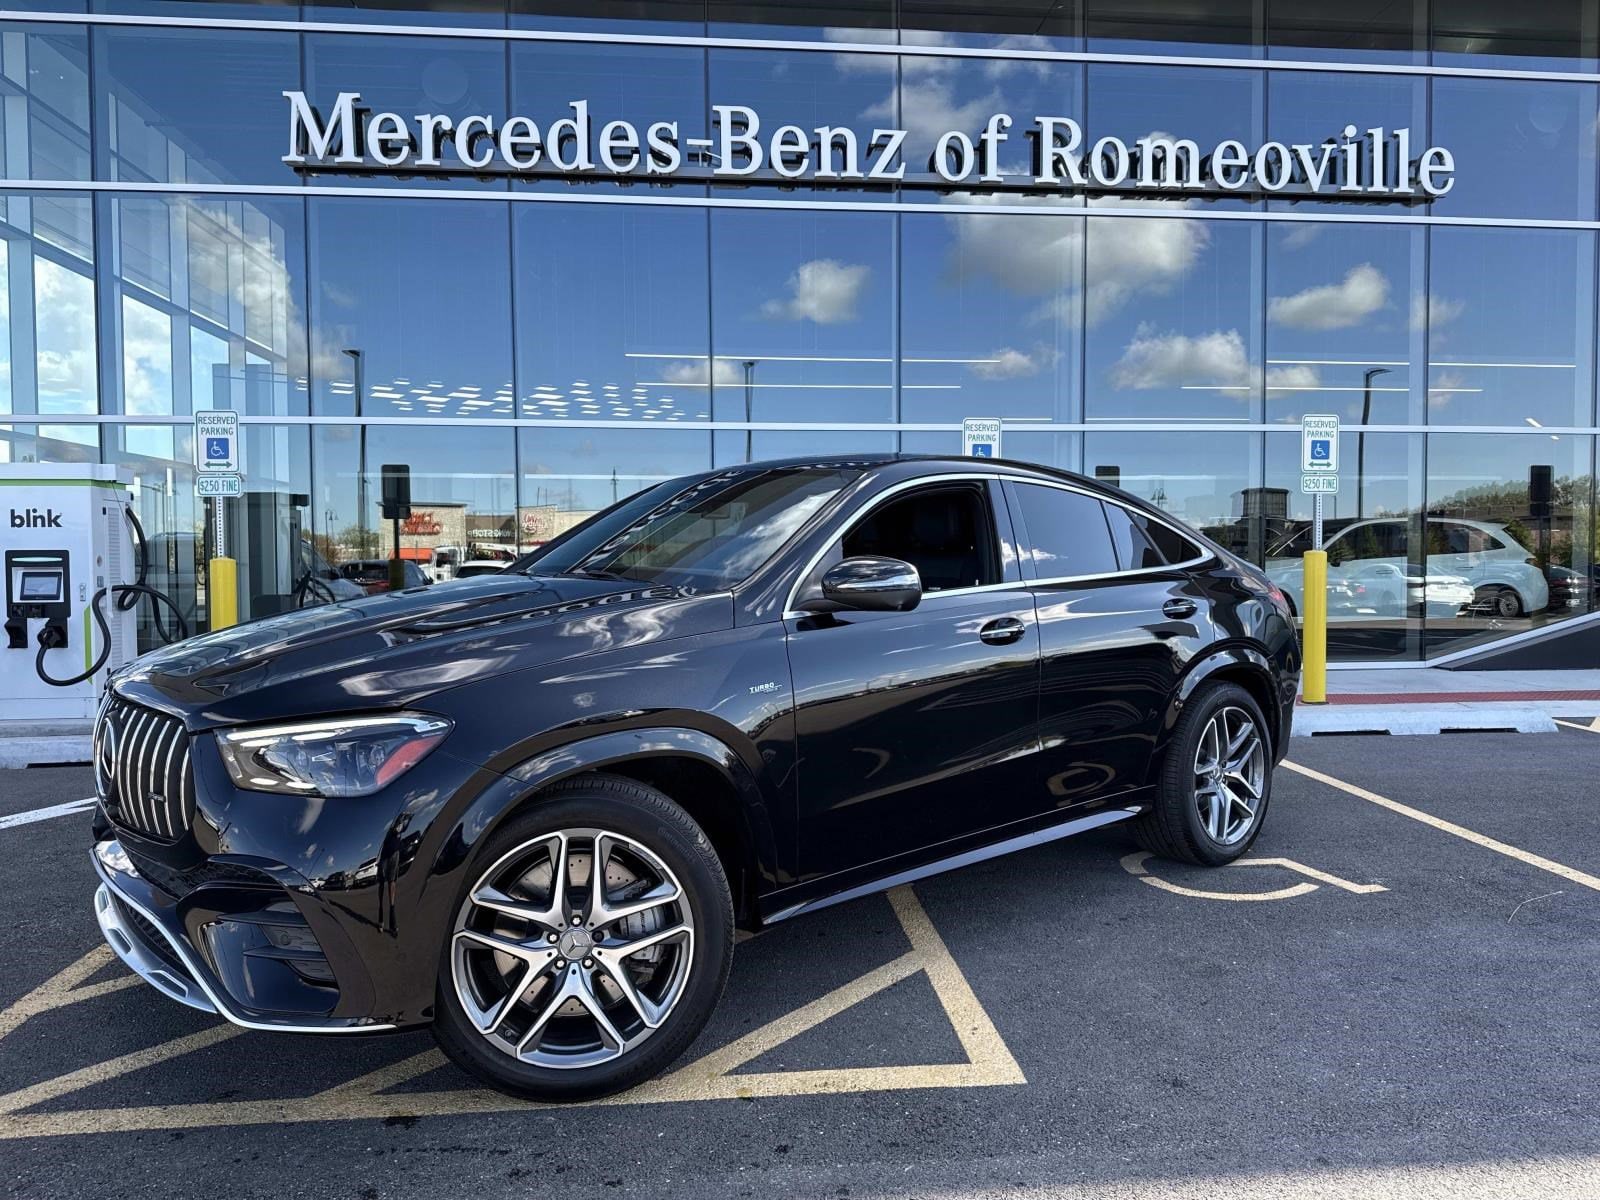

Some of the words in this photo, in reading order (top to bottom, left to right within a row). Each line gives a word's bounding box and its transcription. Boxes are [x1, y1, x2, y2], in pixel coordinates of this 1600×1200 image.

[282, 91, 908, 180] Mercedes-Benz
[934, 113, 1013, 182] of
[1034, 115, 1455, 195] Romeoville
[198, 416, 236, 425] RESERVED
[1305, 420, 1336, 428] RESERVED
[200, 427, 234, 436] PARKING
[965, 423, 999, 431] RESERVED
[967, 433, 997, 442] PARKING
[1307, 430, 1334, 439] PARKING
[200, 480, 220, 492] $250
[222, 479, 238, 492] FINE
[1304, 479, 1320, 489] $250
[1322, 479, 1336, 489] FINE
[10, 508, 64, 528] blink
[749, 682, 775, 694] TURBO
